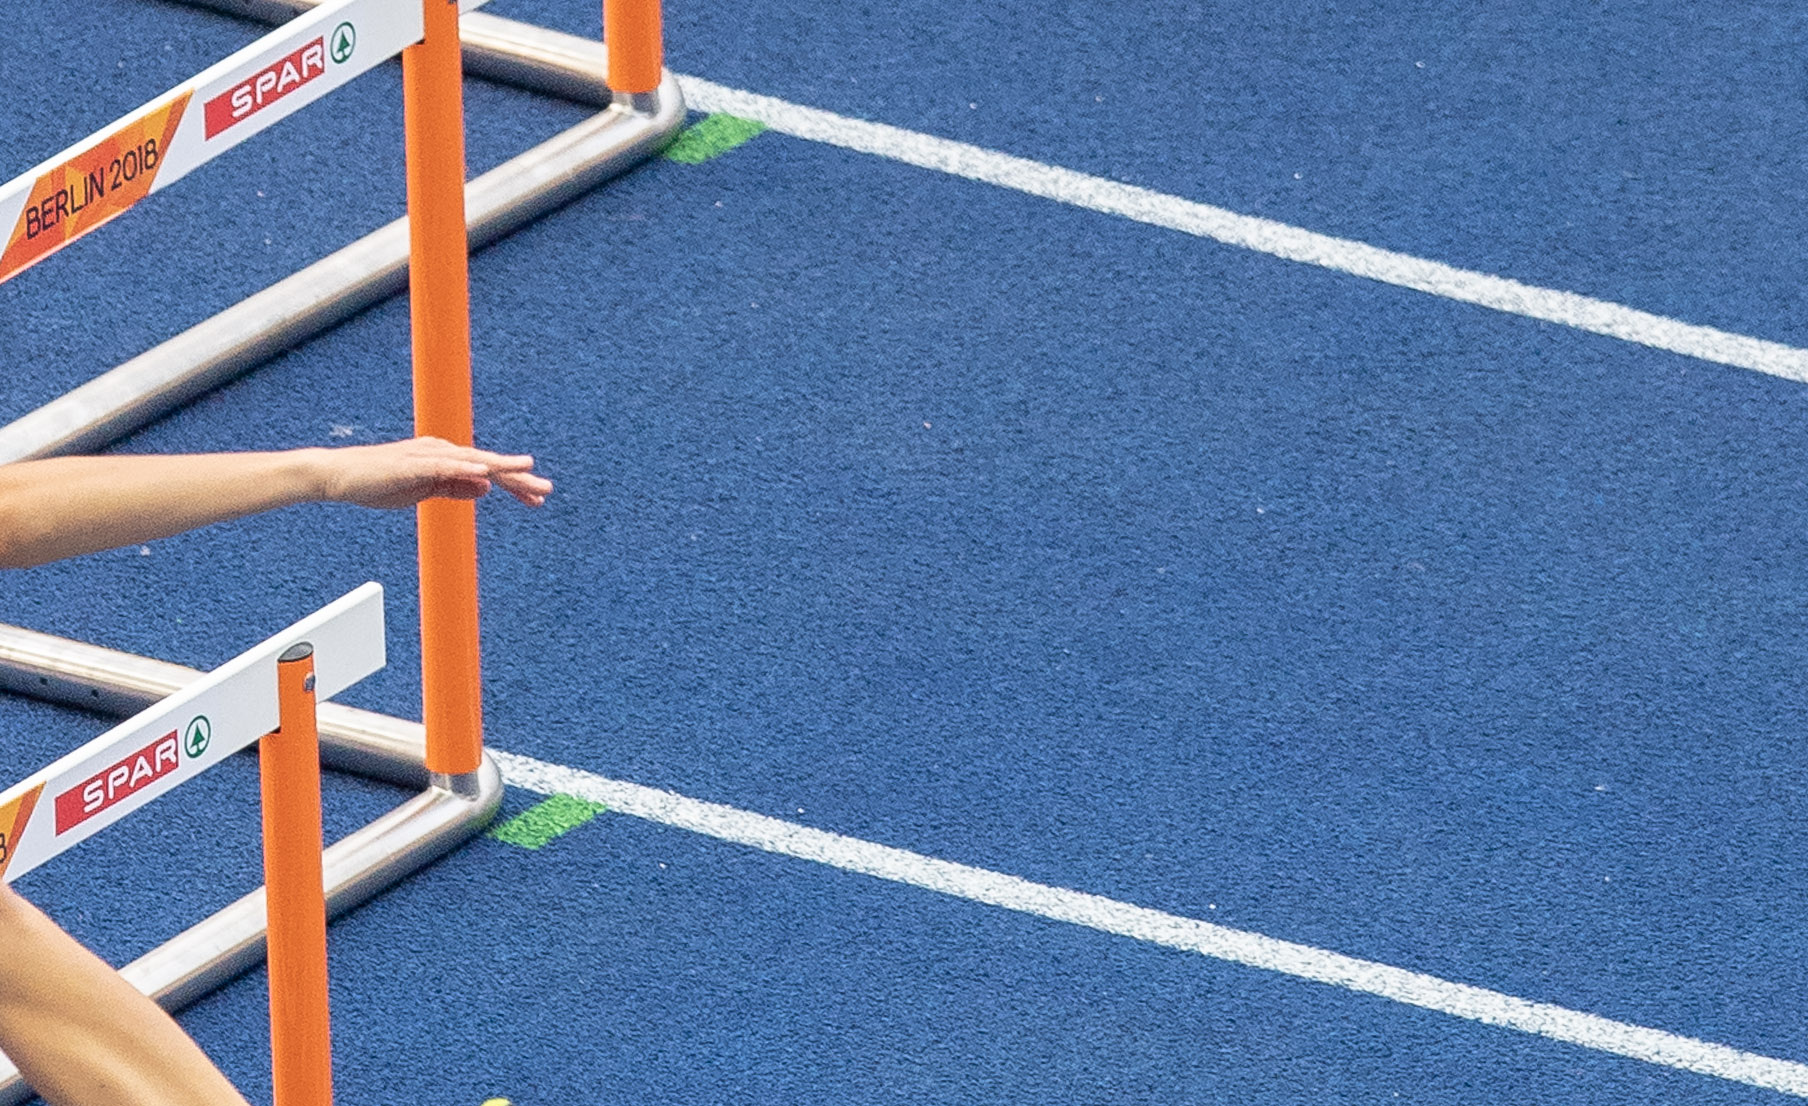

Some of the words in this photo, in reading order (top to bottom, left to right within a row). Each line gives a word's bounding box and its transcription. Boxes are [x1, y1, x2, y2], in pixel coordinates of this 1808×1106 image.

[231, 44, 323, 118] SPAR
[25, 166, 105, 240] BERLIN
[109, 138, 159, 192] 2018
[83, 738, 177, 813] SPAR
